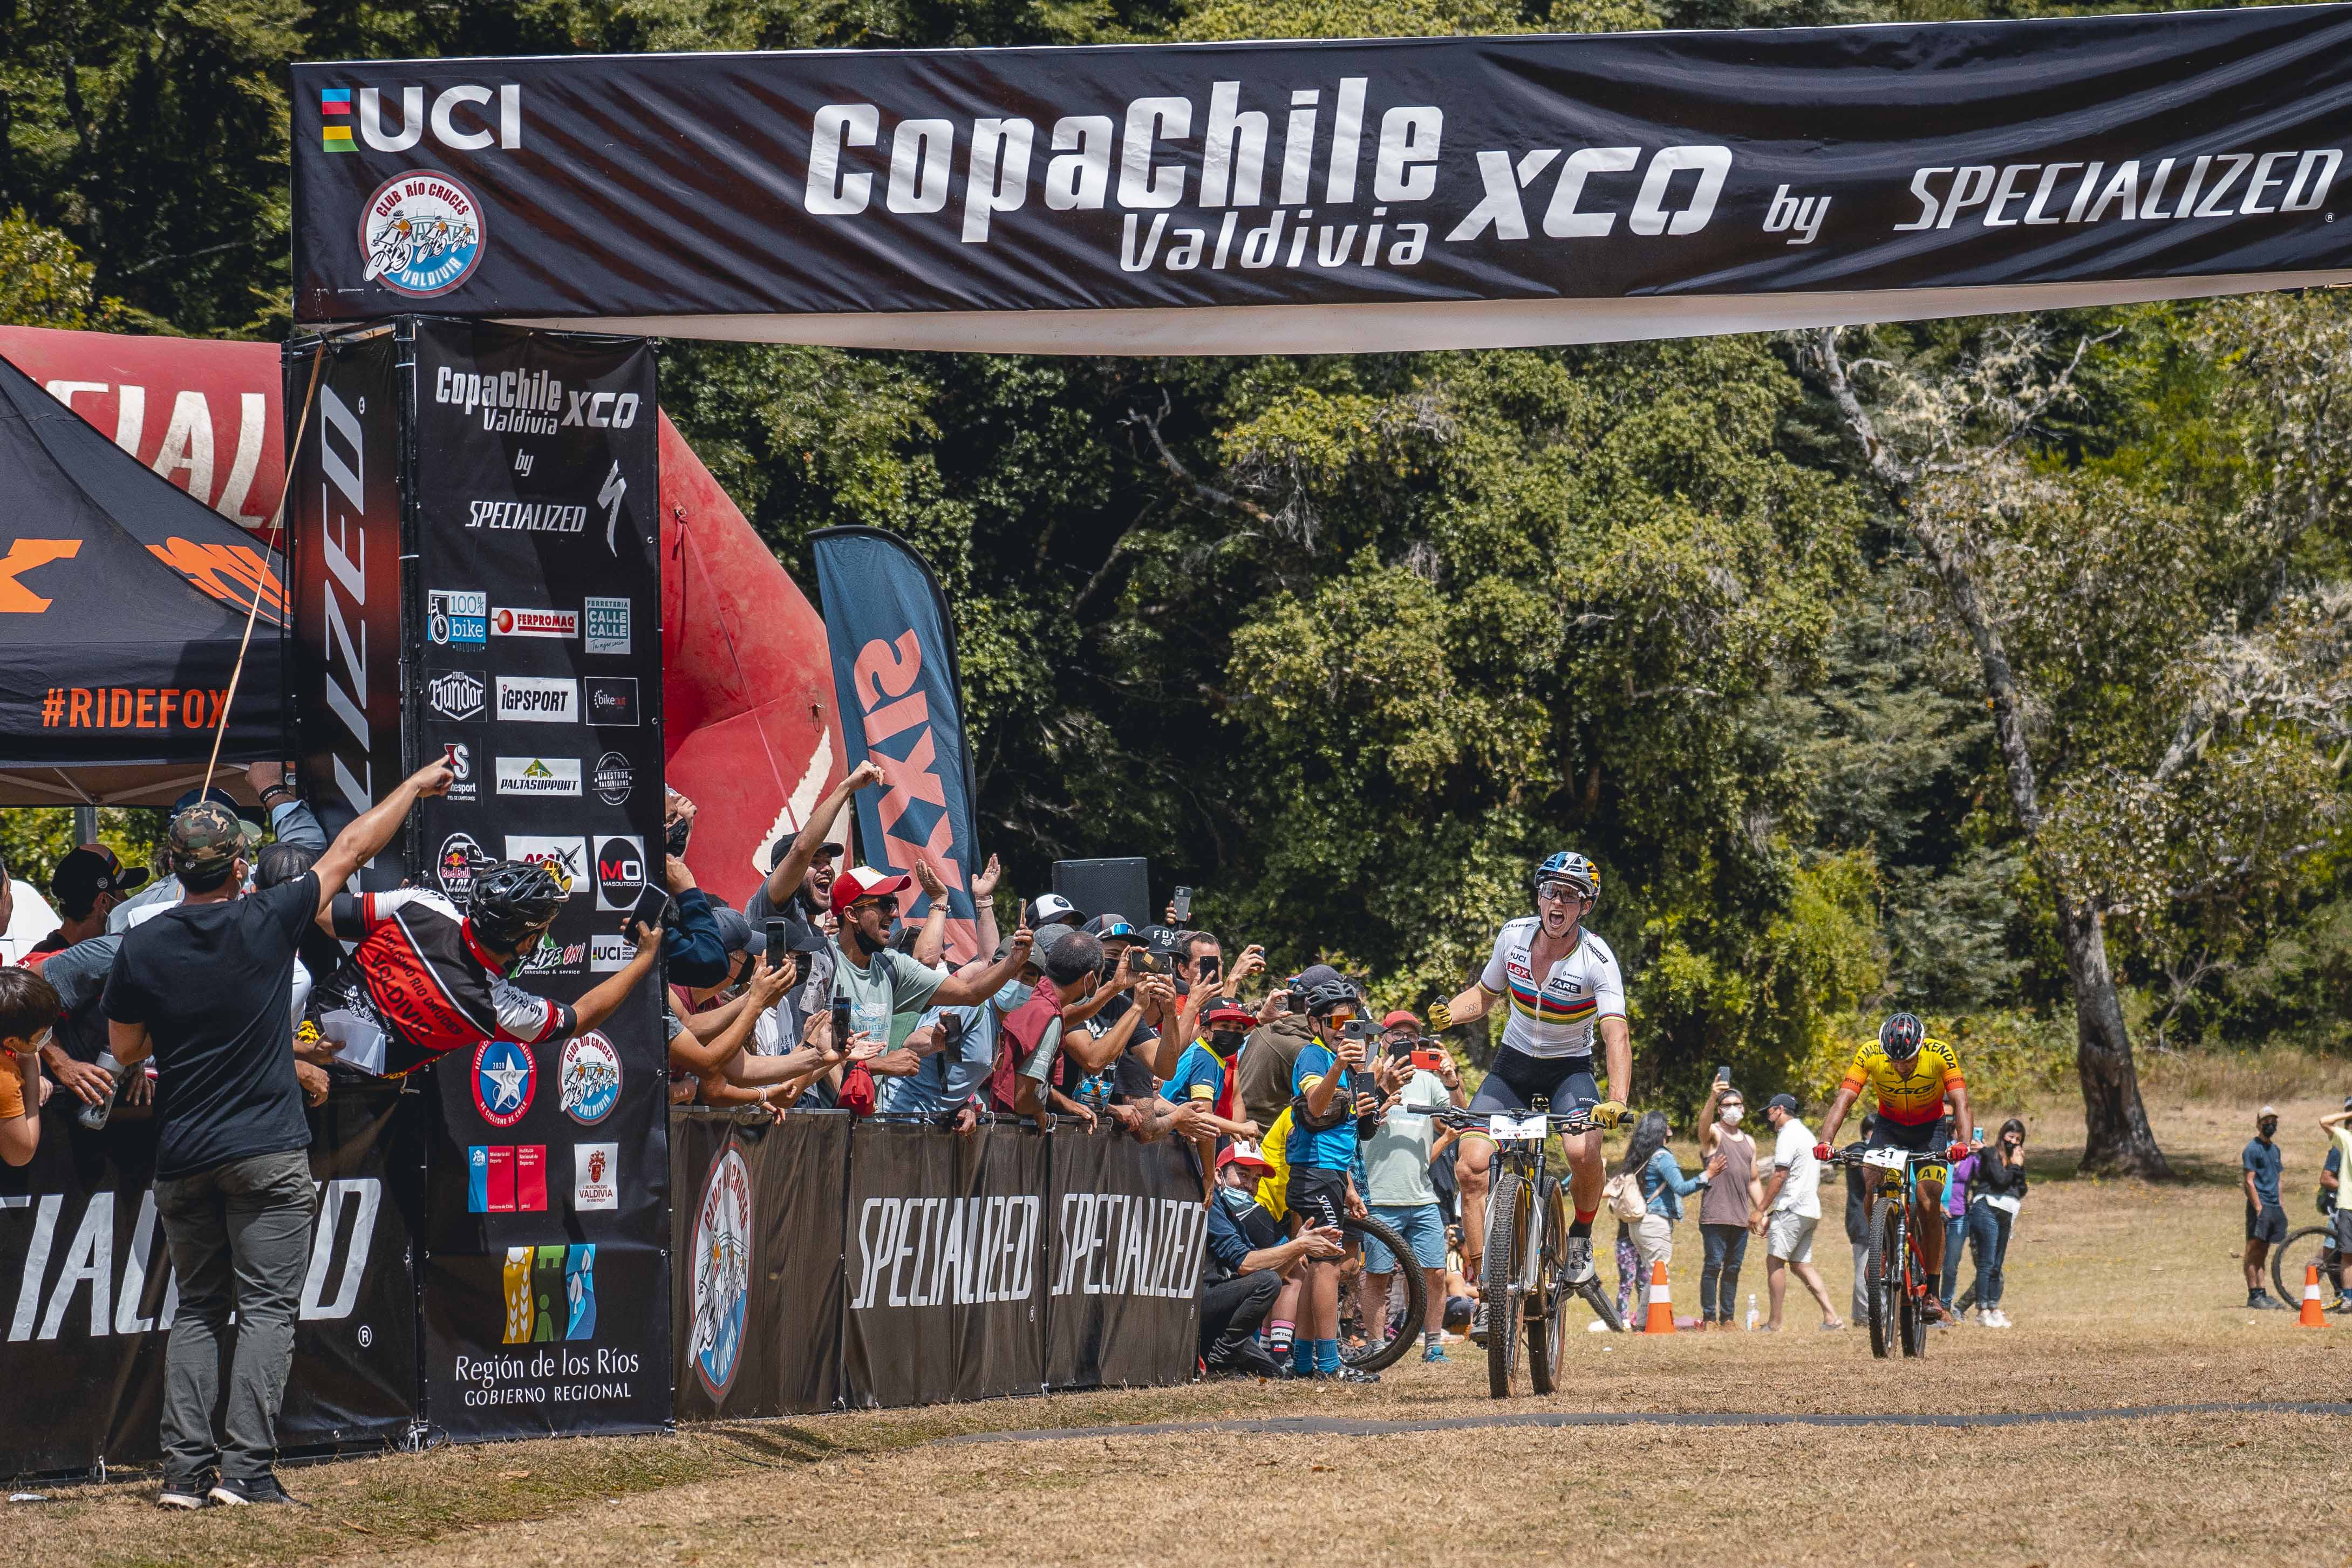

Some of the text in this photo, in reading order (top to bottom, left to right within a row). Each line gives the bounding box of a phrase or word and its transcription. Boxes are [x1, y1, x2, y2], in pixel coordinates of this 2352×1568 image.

[360, 83, 521, 152] UCI
[804, 77, 2343, 245] CopaChile XCO by SPECIALIZED
[376, 181, 469, 217] CLUB RÍO CRUCES
[1120, 207, 1429, 272] Valdivia
[401, 257, 462, 286] VALDIVIA
[436, 366, 639, 428] CopaChile XCO
[483, 408, 557, 435] Valdivia
[514, 449, 534, 476] by
[465, 501, 587, 533] SPECIALIZED
[451, 596, 484, 614] 100%
[589, 611, 626, 623] CALLE
[452, 619, 483, 637] bike
[517, 613, 575, 628] FERPROMAQ
[589, 624, 626, 636] CALLE
[42, 687, 229, 729] #RIDEFOX
[501, 779, 578, 790] PALTASUPPORT
[598, 771, 628, 780] MAESTROS
[1154, 930, 1175, 941] FOX
[597, 946, 621, 960] UCI
[1513, 953, 1526, 963] UCI
[1509, 964, 1528, 977] Lex
[567, 1042, 580, 1062] CLUB
[591, 1037, 613, 1062] CRUCES
[1855, 1055, 1865, 1068] LA
[1924, 1042, 1956, 1070] KENDA
[480, 1101, 527, 1124] DE CICLISMO DE CHILE
[579, 1093, 611, 1116] VALDIVIA
[1877, 1149, 1894, 1159] 21
[579, 1189, 613, 1198] VALDIVIA
[705, 1178, 722, 1232] CLUB
[731, 1163, 747, 1231] CRUCES
[850, 1196, 1040, 1309] SPECIALIZED
[1051, 1193, 1208, 1299] SPECIALIZED
[455, 1347, 639, 1389] Región de los Ríos
[465, 1382, 631, 1406] GOBIERNO REGIONAL
